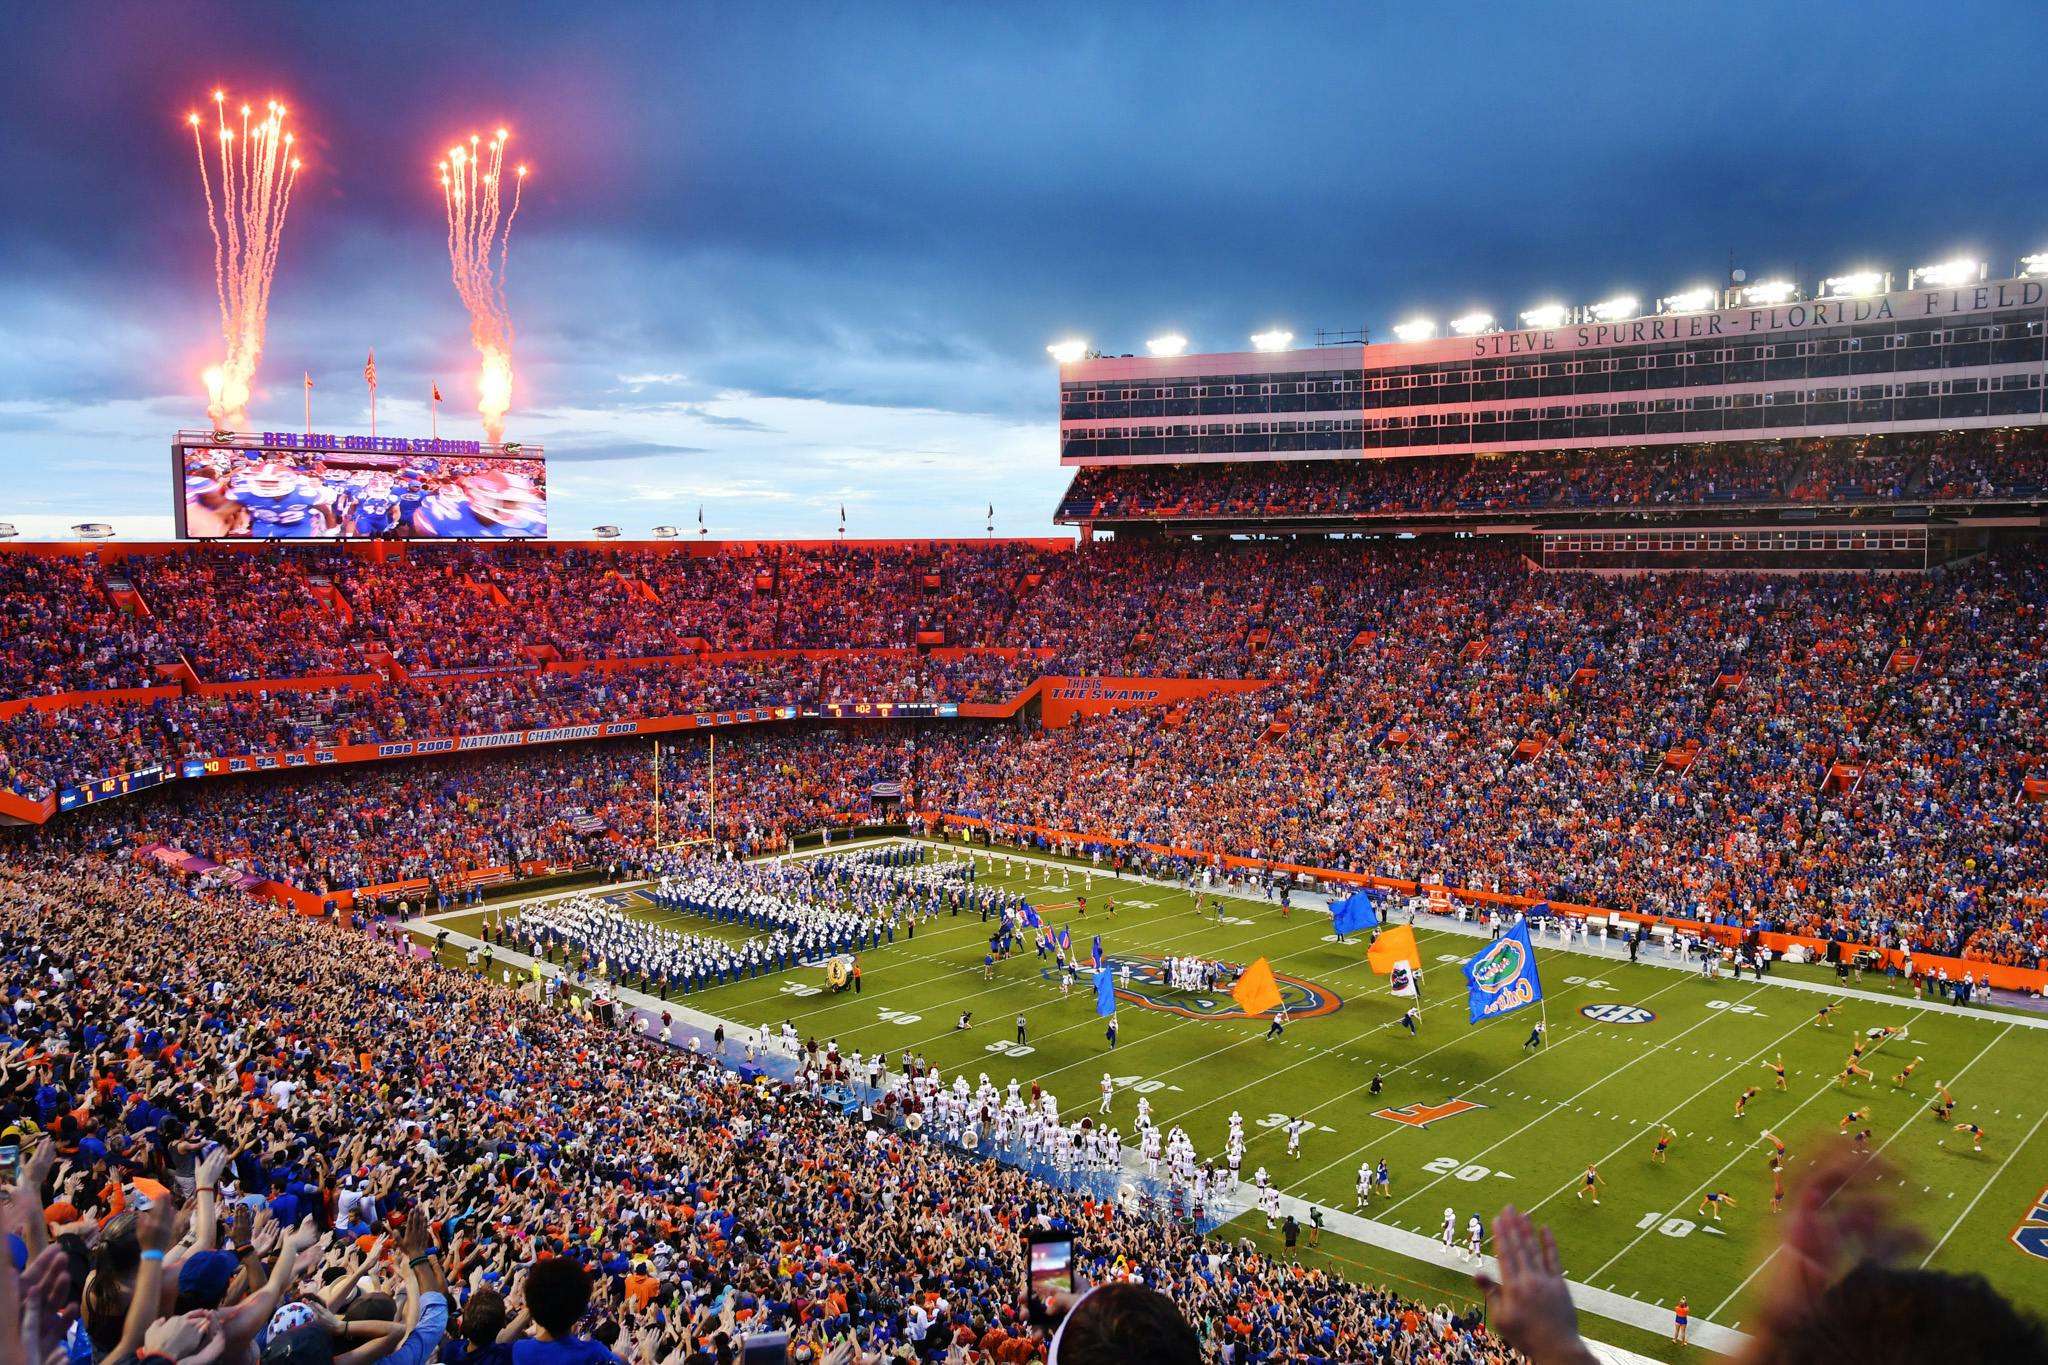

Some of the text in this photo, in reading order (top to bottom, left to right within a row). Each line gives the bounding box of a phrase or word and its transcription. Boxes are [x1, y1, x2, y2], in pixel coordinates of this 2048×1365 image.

[1474, 331, 1555, 357] STEVE
[1924, 282, 2043, 315] FIELD
[263, 432, 480, 455] BEN HILL GRIFFIN STADIUM
[1066, 679, 1102, 689] THIS IS
[1052, 688, 1159, 701] THE SWAMP
[379, 722, 637, 756] 1996 2006 NATIONAL CHAMPIONS 2008
[256, 757, 276, 769] 93
[285, 753, 305, 766] 94
[314, 750, 335, 762] 95
[203, 760, 220, 772] 40
[229, 758, 246, 770] 91
[984, 1039, 1036, 1058] 50
[1109, 1075, 1166, 1093] 40
[1421, 1157, 1492, 1181] 20
[1635, 1211, 1697, 1238] 10
